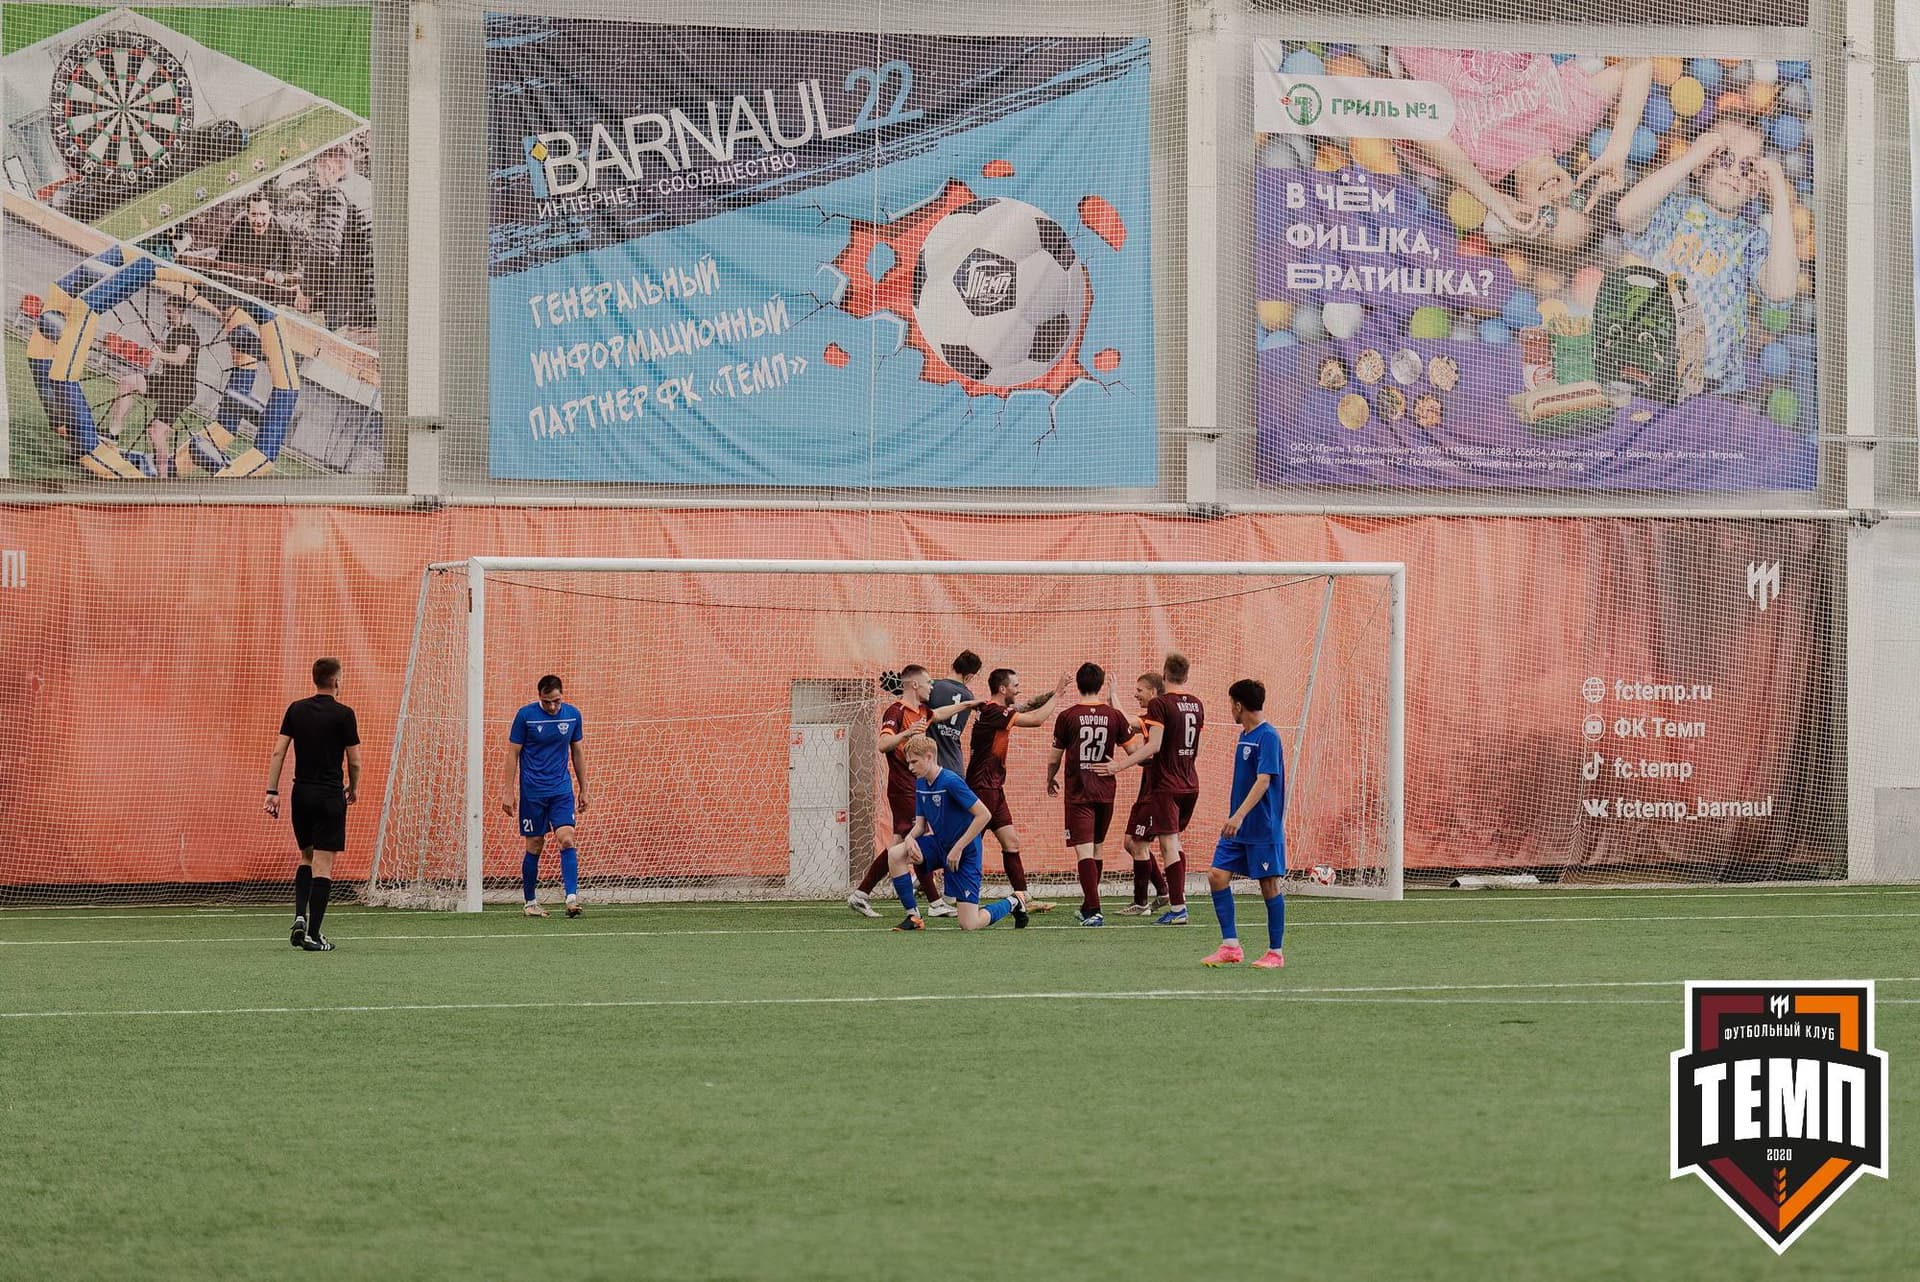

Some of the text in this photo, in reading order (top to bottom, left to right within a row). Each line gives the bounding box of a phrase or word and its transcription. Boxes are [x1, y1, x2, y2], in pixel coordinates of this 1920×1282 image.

[1332, 98, 1439, 120] ГРИЛЬ №1
[536, 184, 640, 219] ИНТЕРНЕТ
[659, 151, 796, 195] СООБЩЕСТВО
[1286, 173, 1396, 213] В ЧЁМ
[1286, 223, 1440, 260] ФИШКА,
[528, 252, 720, 329] ГЕНЕРАЛЬНЫЙ
[1286, 263, 1496, 296] БРАТИШКА?
[529, 293, 790, 388] ИНФОРМАЦИОННЫЙ
[528, 352, 808, 441] ПАРТНЕР ФК «ТЕМП»
[1615, 680, 1713, 704] fctemp.ru
[1080, 726, 1109, 761] 23
[1185, 713, 1197, 748] 6
[1614, 717, 1706, 738] ФК Темп
[1613, 757, 1692, 782] fc.temp
[1616, 796, 1772, 821] fctemp_barnaul
[522, 819, 534, 833] 21
[1135, 824, 1146, 837] 20
